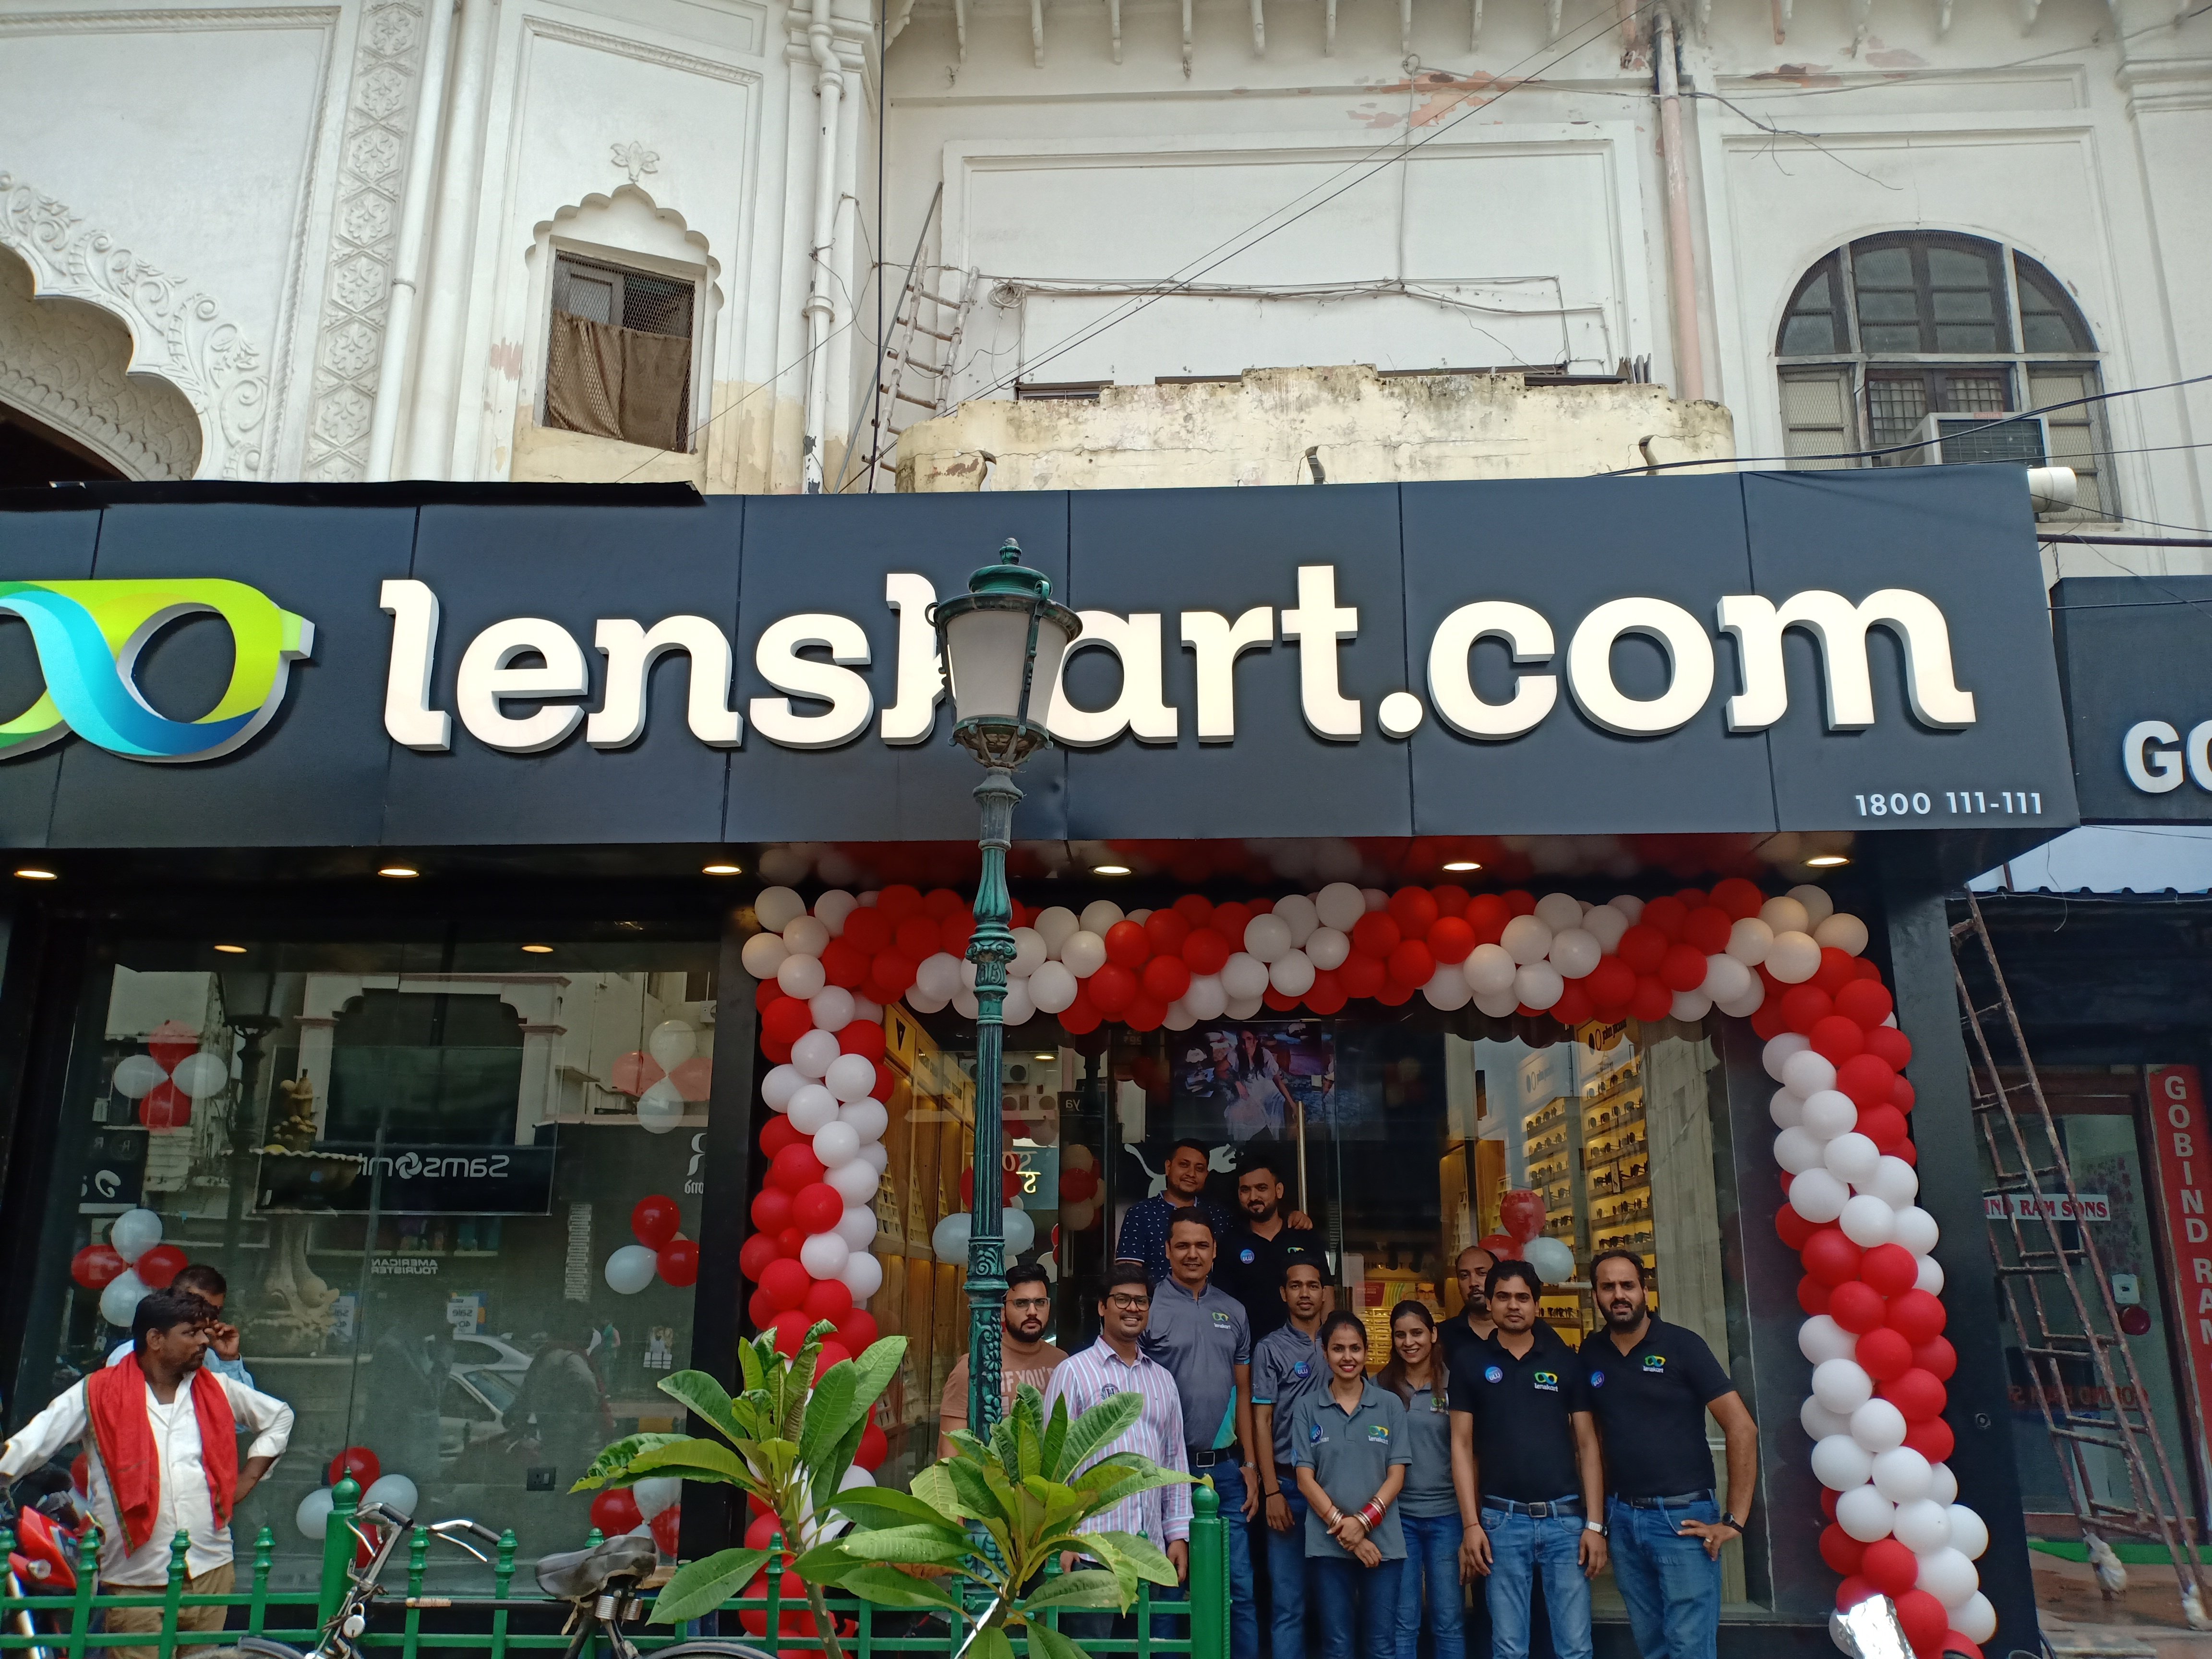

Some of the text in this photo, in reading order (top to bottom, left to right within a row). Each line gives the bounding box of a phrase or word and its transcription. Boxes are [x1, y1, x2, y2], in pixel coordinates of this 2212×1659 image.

[380, 565, 1976, 753] lenskart.com
[1855, 791, 2042, 817] 1800 111-111
[2165, 1076, 2208, 1243] GOBIND
[1534, 1382, 1559, 1393] lenskart
